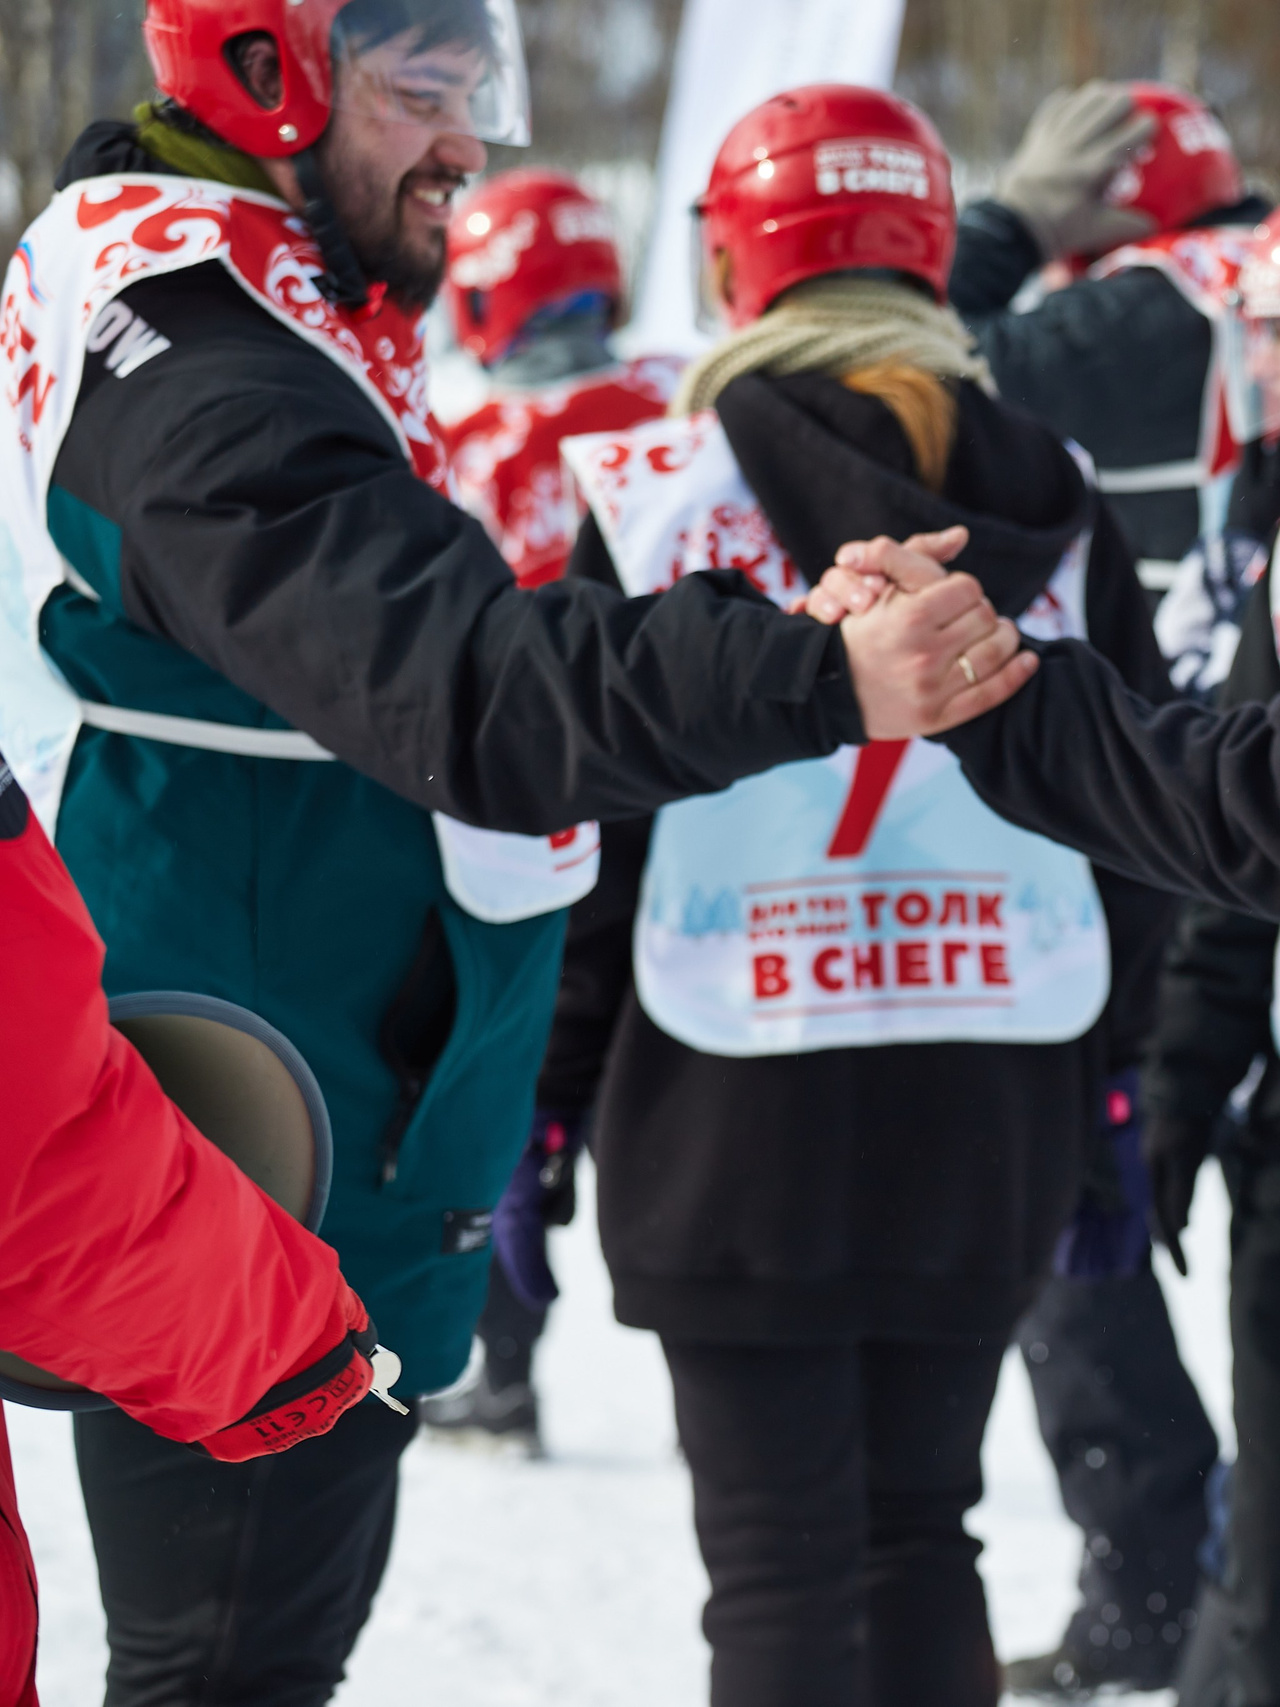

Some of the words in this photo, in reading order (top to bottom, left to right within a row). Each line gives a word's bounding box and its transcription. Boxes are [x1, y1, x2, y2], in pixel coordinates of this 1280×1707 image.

[860, 890, 1003, 930] ТОЛК
[753, 953, 790, 999] В
[812, 942, 1010, 992] СНЕГЕ
